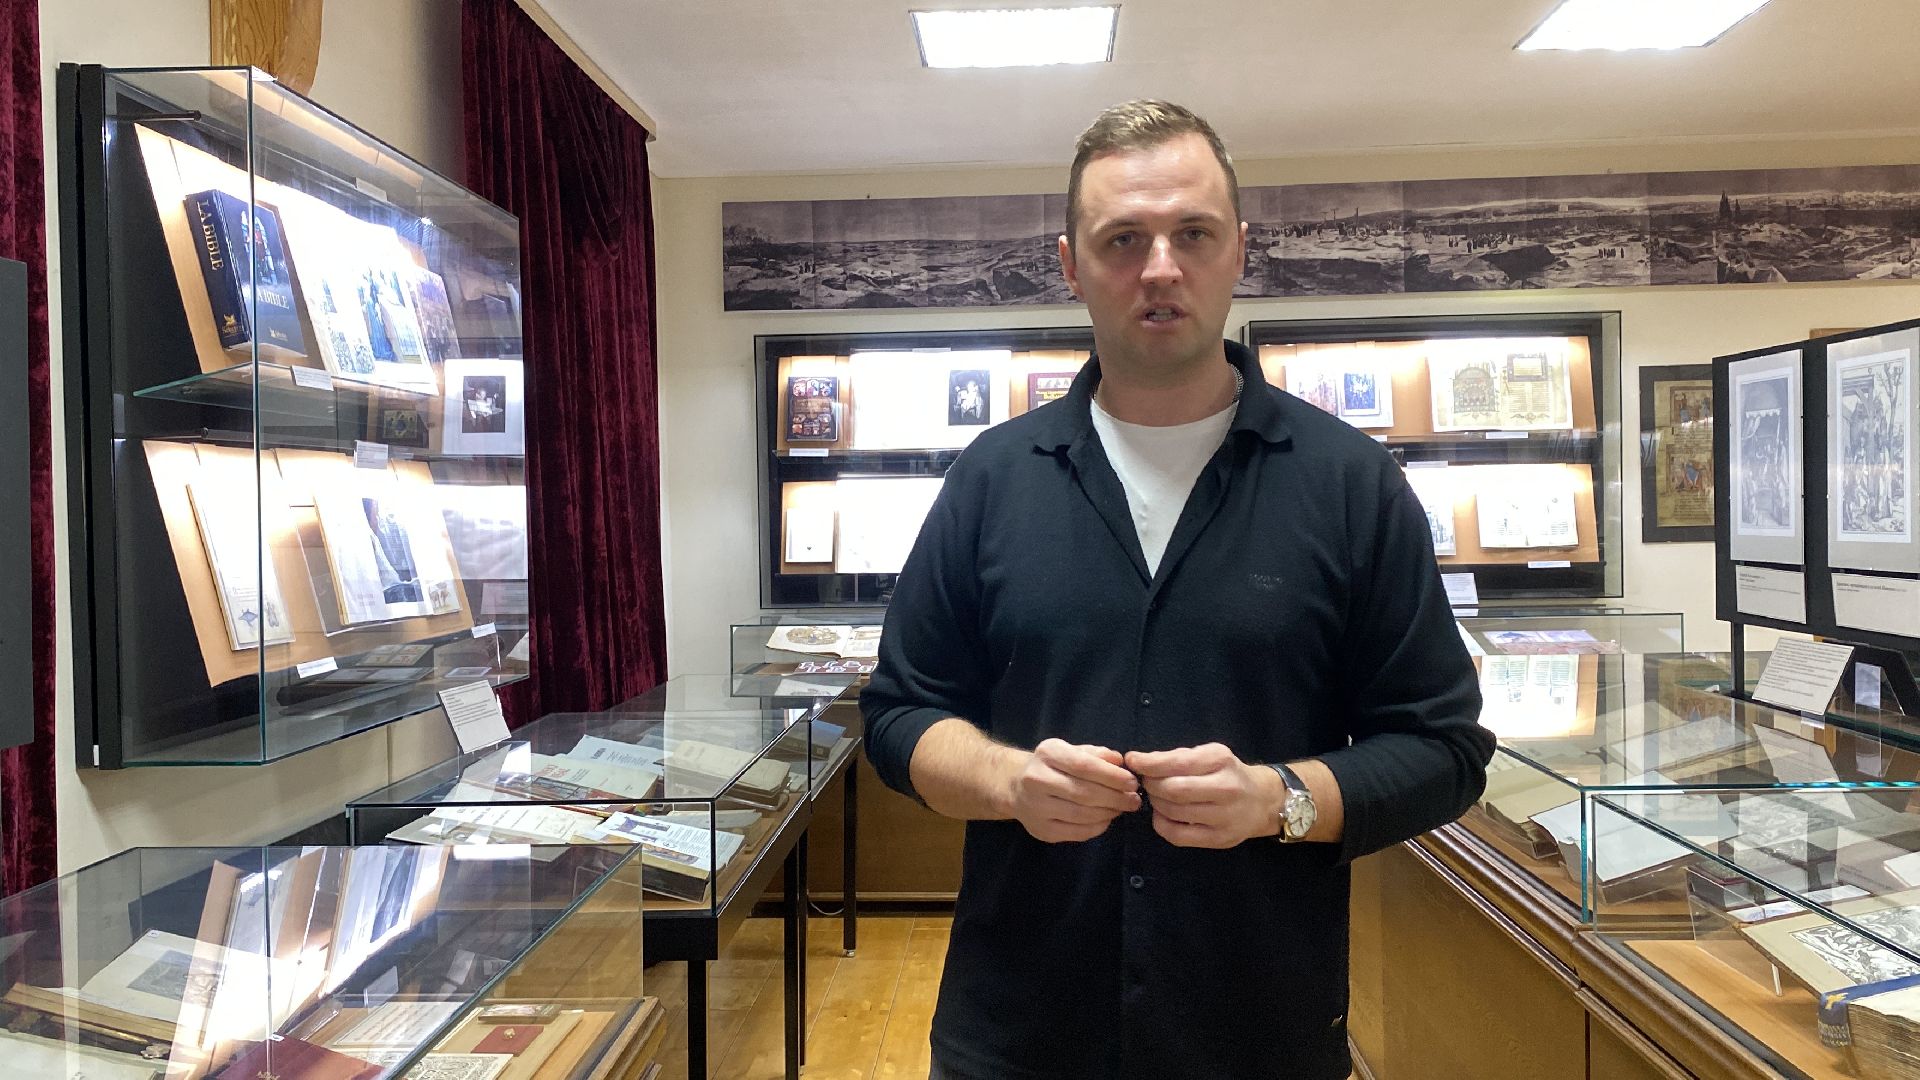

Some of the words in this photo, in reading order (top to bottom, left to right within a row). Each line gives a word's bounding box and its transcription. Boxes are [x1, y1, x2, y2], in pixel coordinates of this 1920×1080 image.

[196, 199, 212, 223] LA
[202, 223, 224, 271] BIBLE
[263, 289, 290, 309] BIBLE
